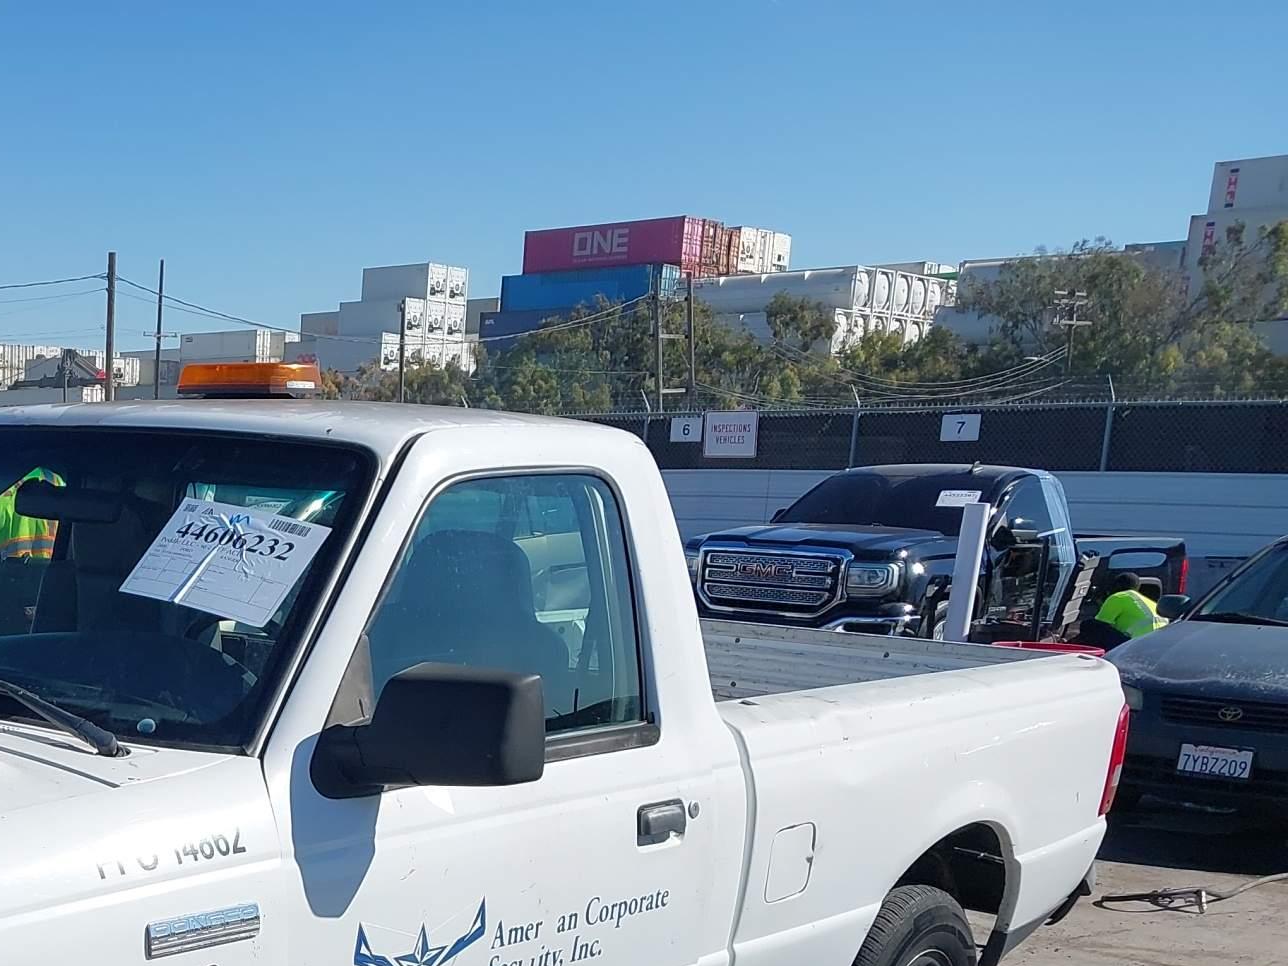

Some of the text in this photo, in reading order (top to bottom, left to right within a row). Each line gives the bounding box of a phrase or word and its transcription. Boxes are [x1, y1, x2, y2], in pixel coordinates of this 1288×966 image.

[573, 228, 630, 256] ONE
[682, 424, 690, 436] 6
[711, 423, 751, 433] INSPECTIONS
[956, 421, 966, 434] 7
[716, 435, 745, 444] VEHICLES
[176, 521, 296, 561] 44606232
[738, 562, 793, 577] GMC
[1183, 753, 1248, 778] 7YBZ209
[491, 889, 669, 949] Ameran Corporate
[570, 936, 602, 962] Inc.
